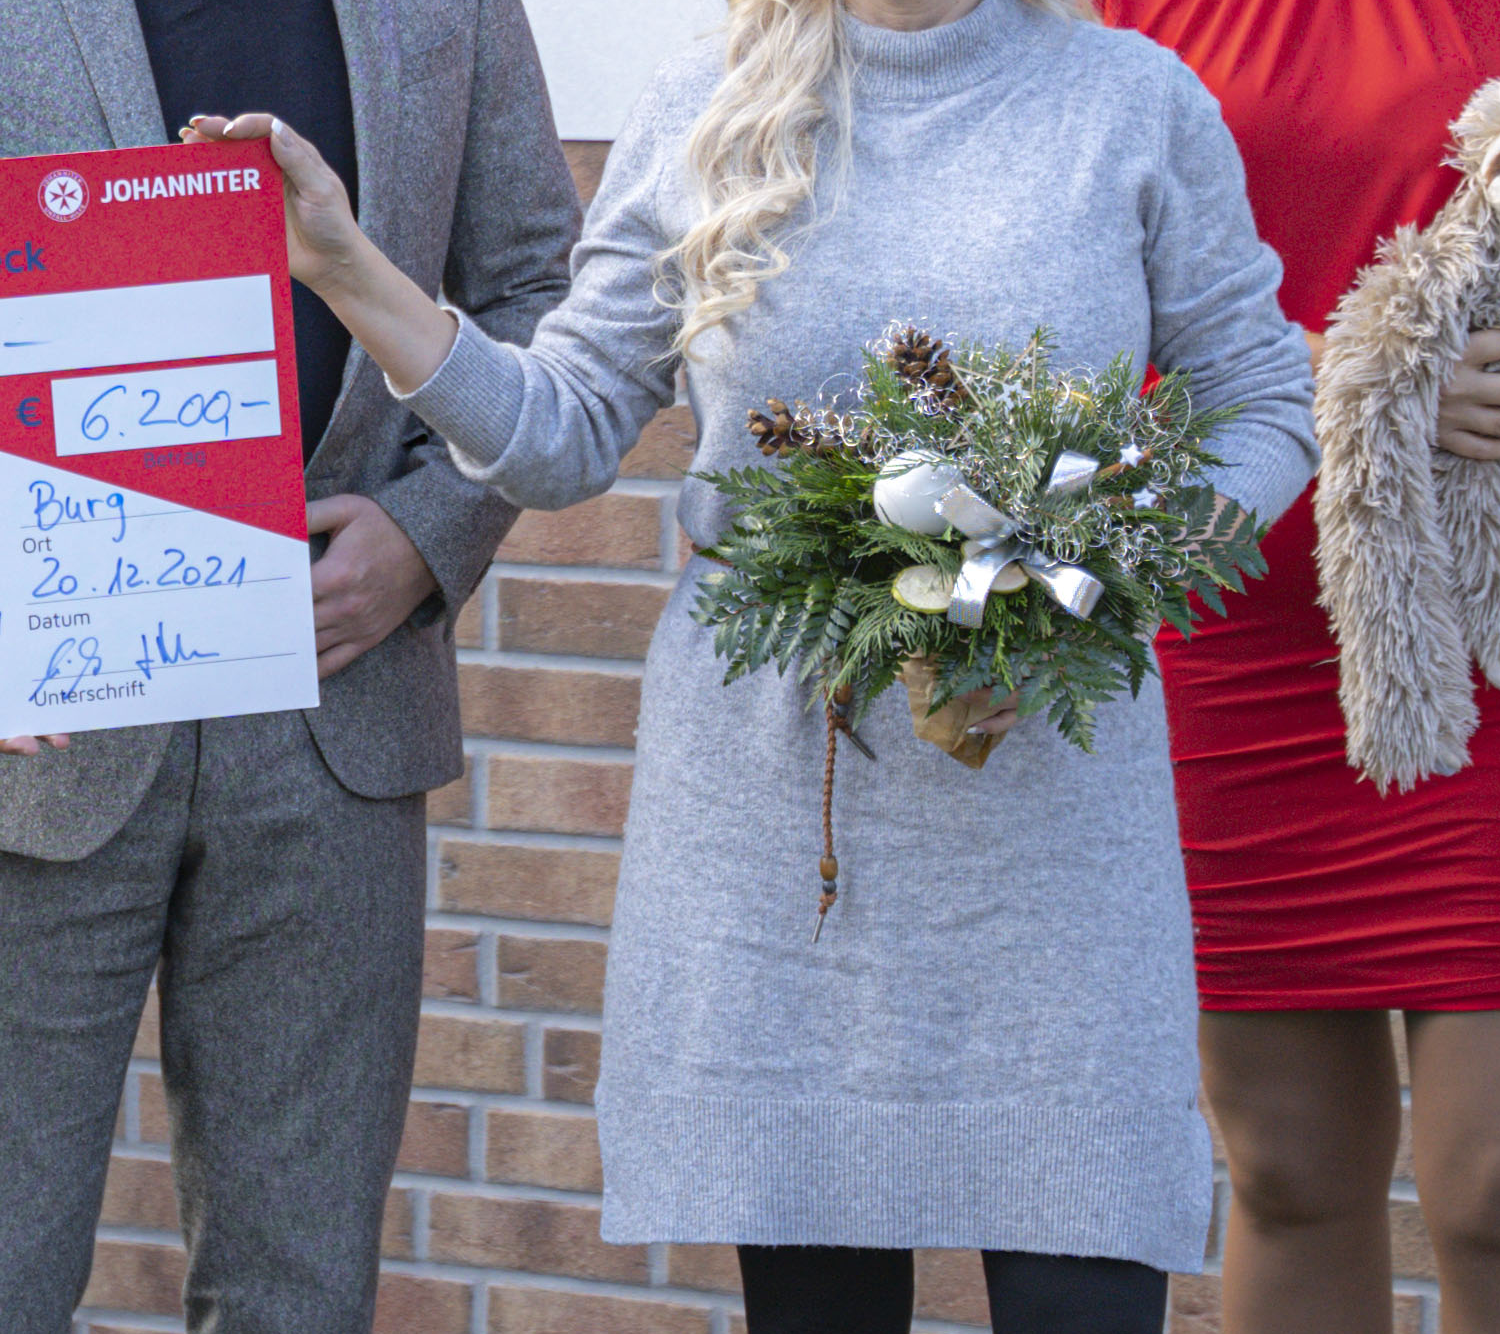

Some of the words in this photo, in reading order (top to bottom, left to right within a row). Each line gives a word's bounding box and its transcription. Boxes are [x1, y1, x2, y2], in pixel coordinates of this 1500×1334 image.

[101, 168, 261, 204] JOHANNITER
[15, 397, 43, 427] €
[143, 451, 206, 469] Betrag
[28, 480, 126, 543] Burg
[22, 537, 52, 554] Ort
[28, 612, 91, 631] Datum
[33, 680, 147, 707] Unterschrift
